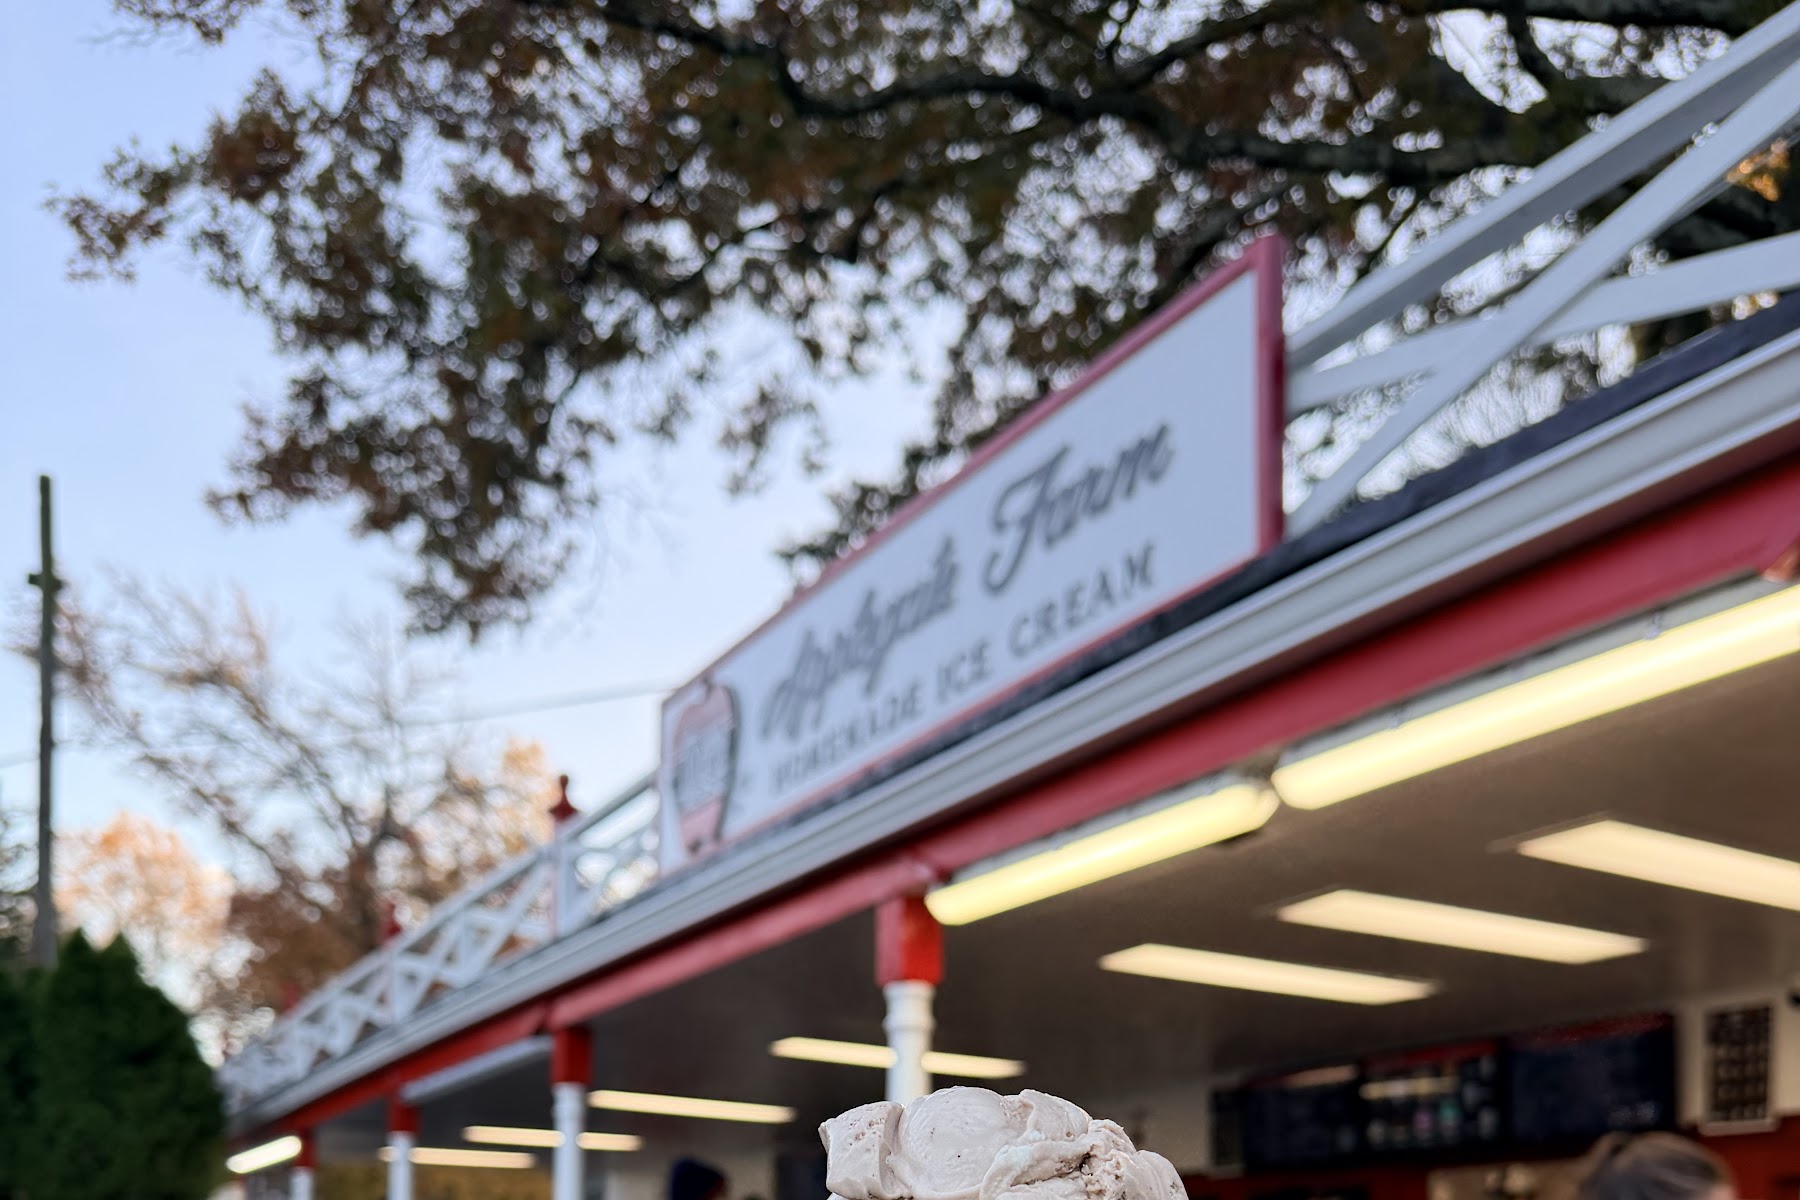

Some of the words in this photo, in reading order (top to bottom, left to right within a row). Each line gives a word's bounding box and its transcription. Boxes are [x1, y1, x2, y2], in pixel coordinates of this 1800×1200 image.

[982, 424, 1173, 597] Farm
[937, 641, 992, 703] ICE
[1008, 542, 1156, 656] CREAM
